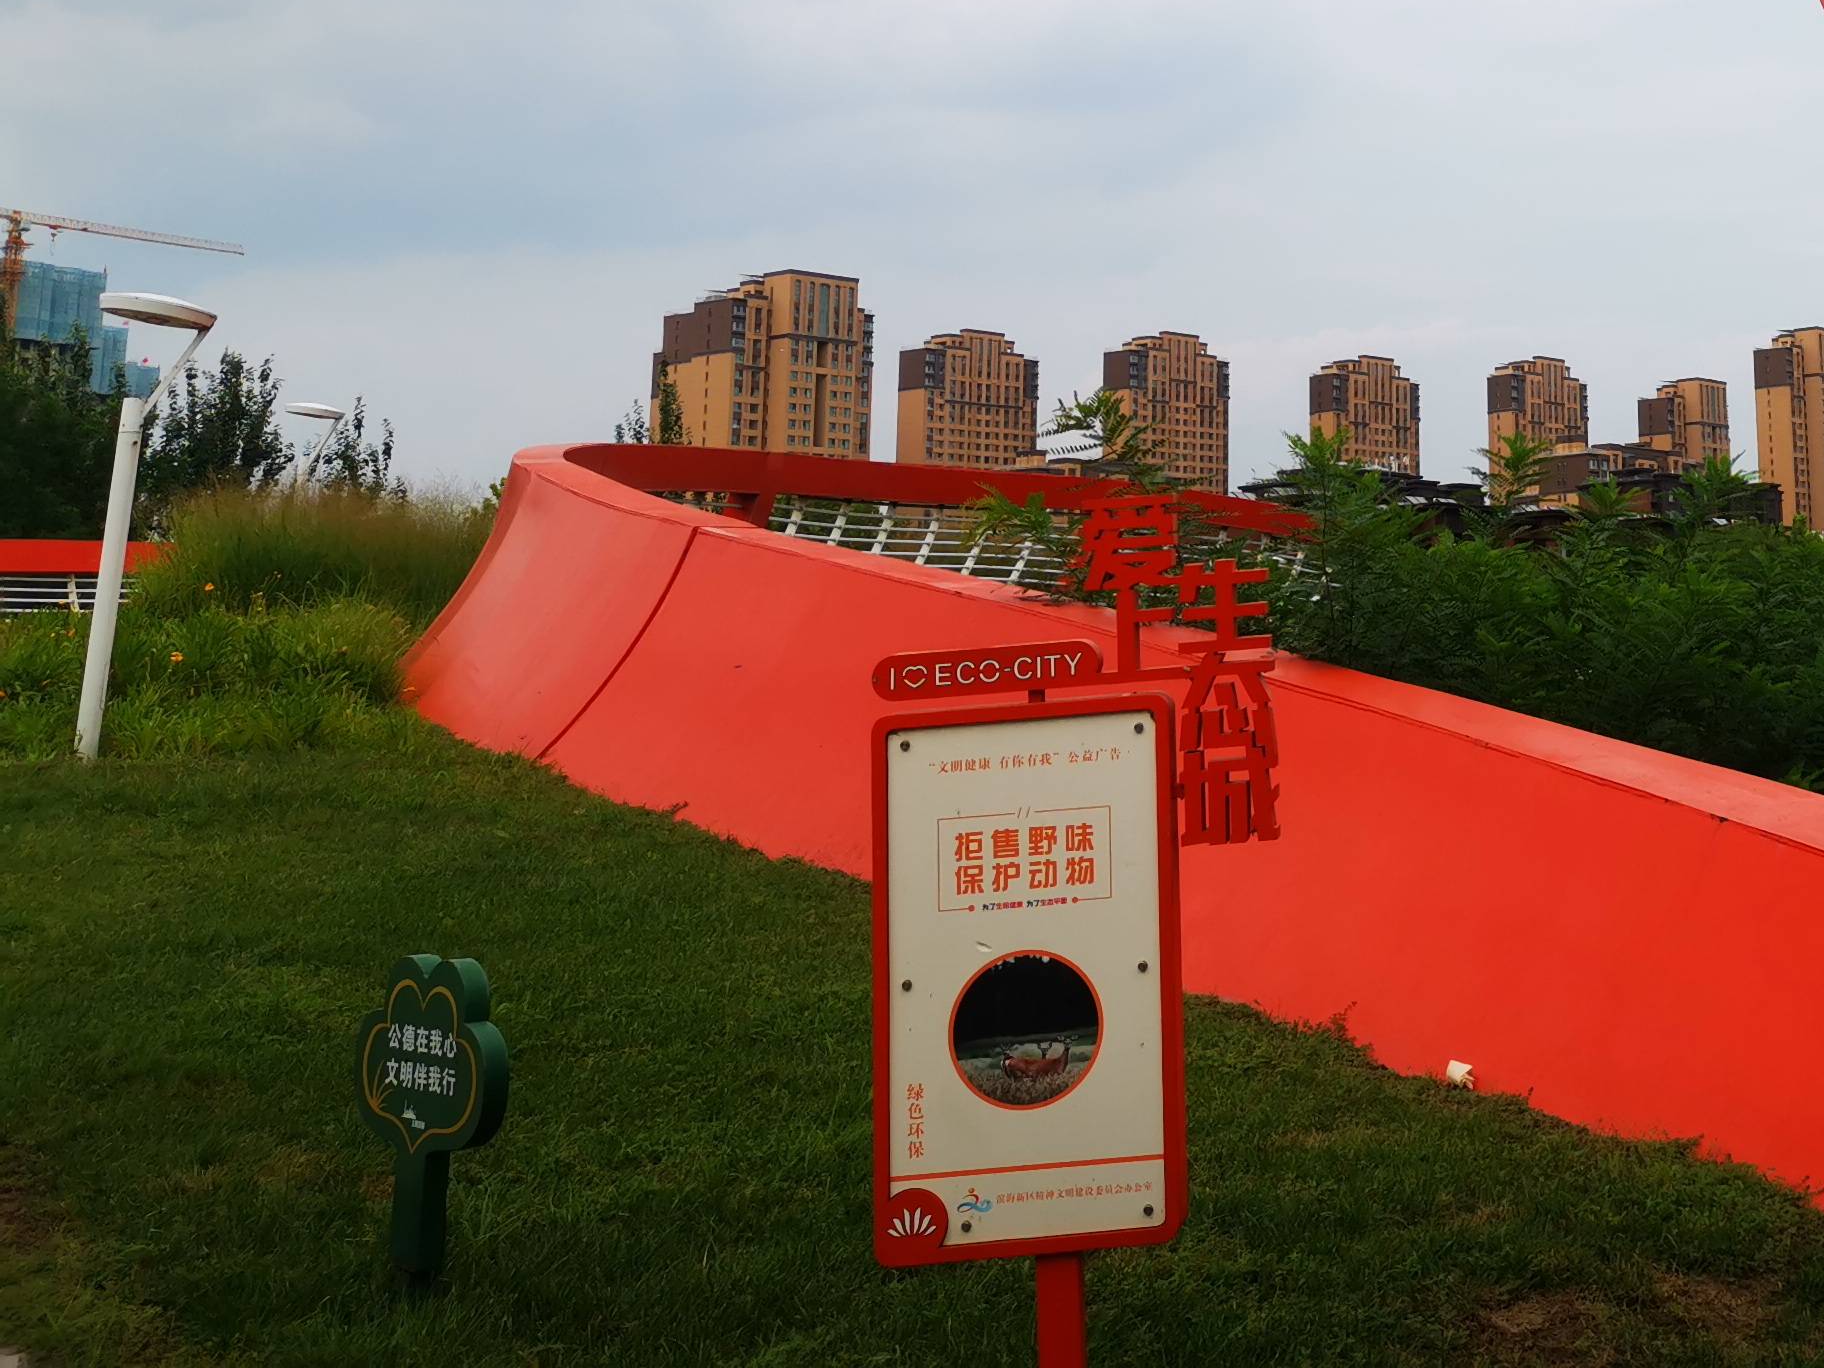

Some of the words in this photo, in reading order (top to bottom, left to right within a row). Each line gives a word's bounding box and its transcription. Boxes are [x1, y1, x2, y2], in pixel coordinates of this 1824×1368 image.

[935, 652, 1083, 687] ECO-CITY
[1068, 746, 1121, 764] 公益广告
[954, 822, 1095, 863] 拒售野味
[954, 855, 1096, 897] 保护动物
[388, 1023, 458, 1058] 公德在我心
[384, 1057, 457, 1097] 文明伴我行
[906, 1082, 925, 1160] 绿色环保
